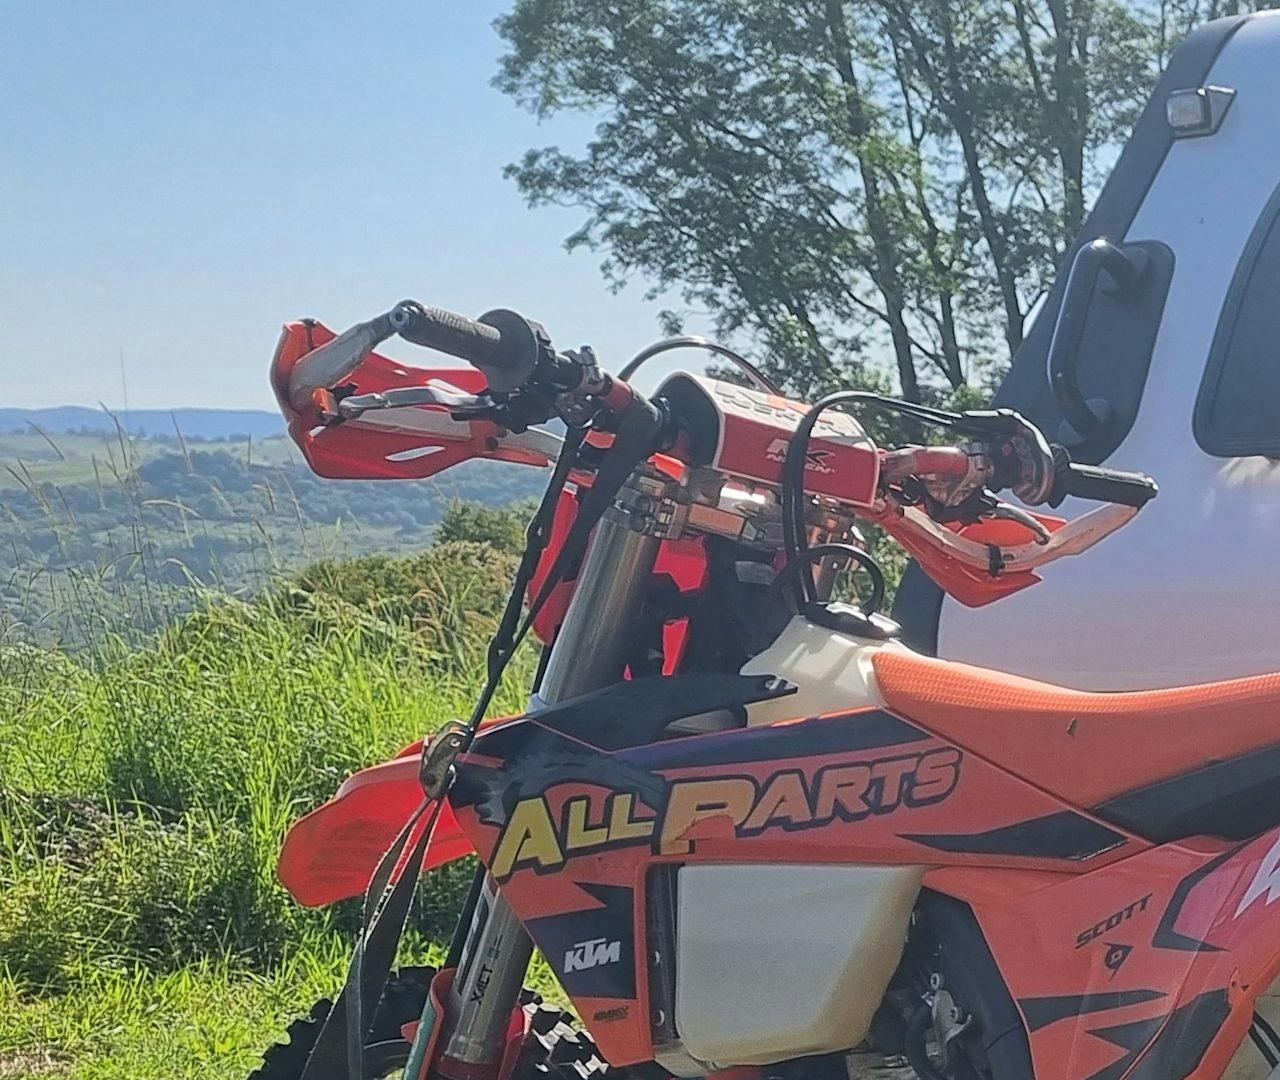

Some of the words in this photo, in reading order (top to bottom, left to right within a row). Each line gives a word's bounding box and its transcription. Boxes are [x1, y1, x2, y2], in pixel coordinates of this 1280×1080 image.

[1074, 892, 1153, 950] SCOTT
[563, 937, 622, 974] KTM
[470, 963, 493, 1006] XACT
